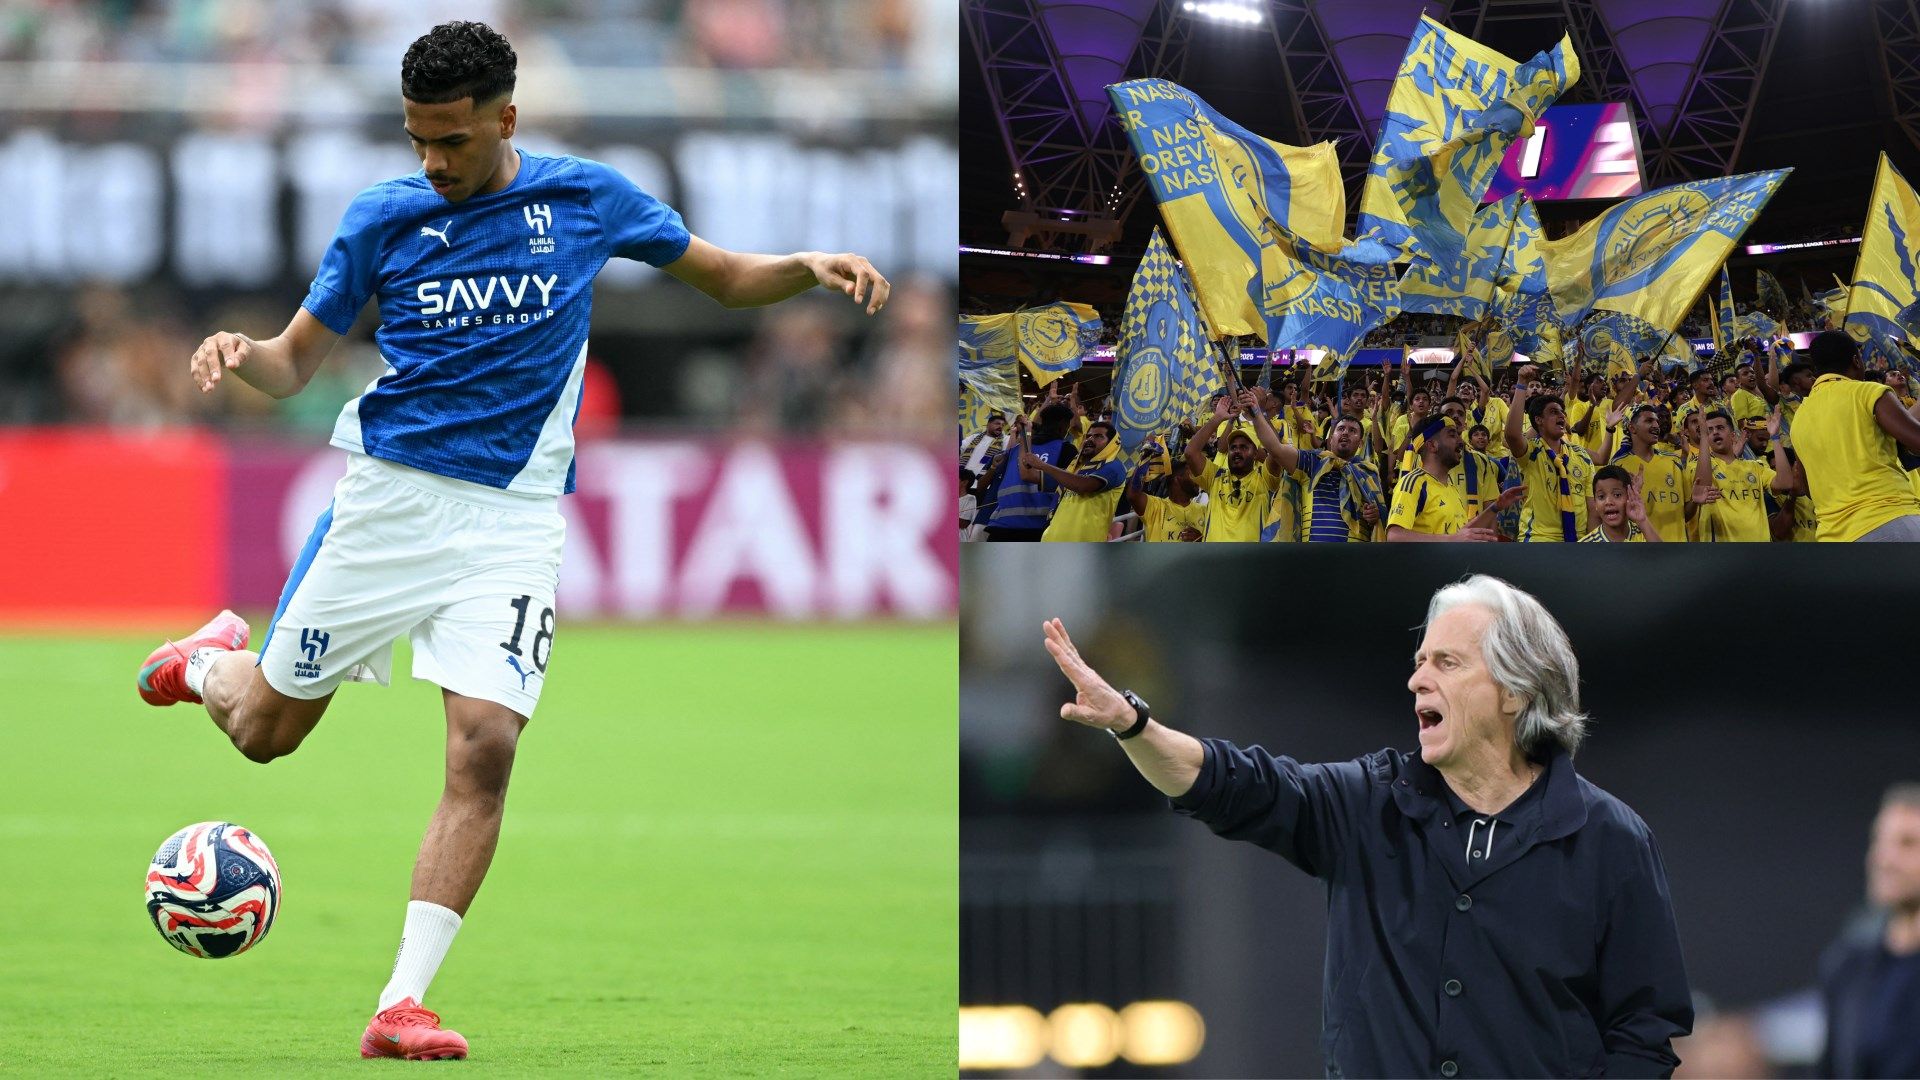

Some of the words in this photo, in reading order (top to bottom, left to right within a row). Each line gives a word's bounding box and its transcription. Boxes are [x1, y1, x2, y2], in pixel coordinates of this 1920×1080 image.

[529, 237, 555, 245] ALHILAL
[417, 274, 558, 315] SAVVY
[421, 315, 483, 329] GAMES
[493, 309, 554, 324] GROUP
[500, 595, 554, 673] 18
[294, 661, 322, 671] ALHILAL
